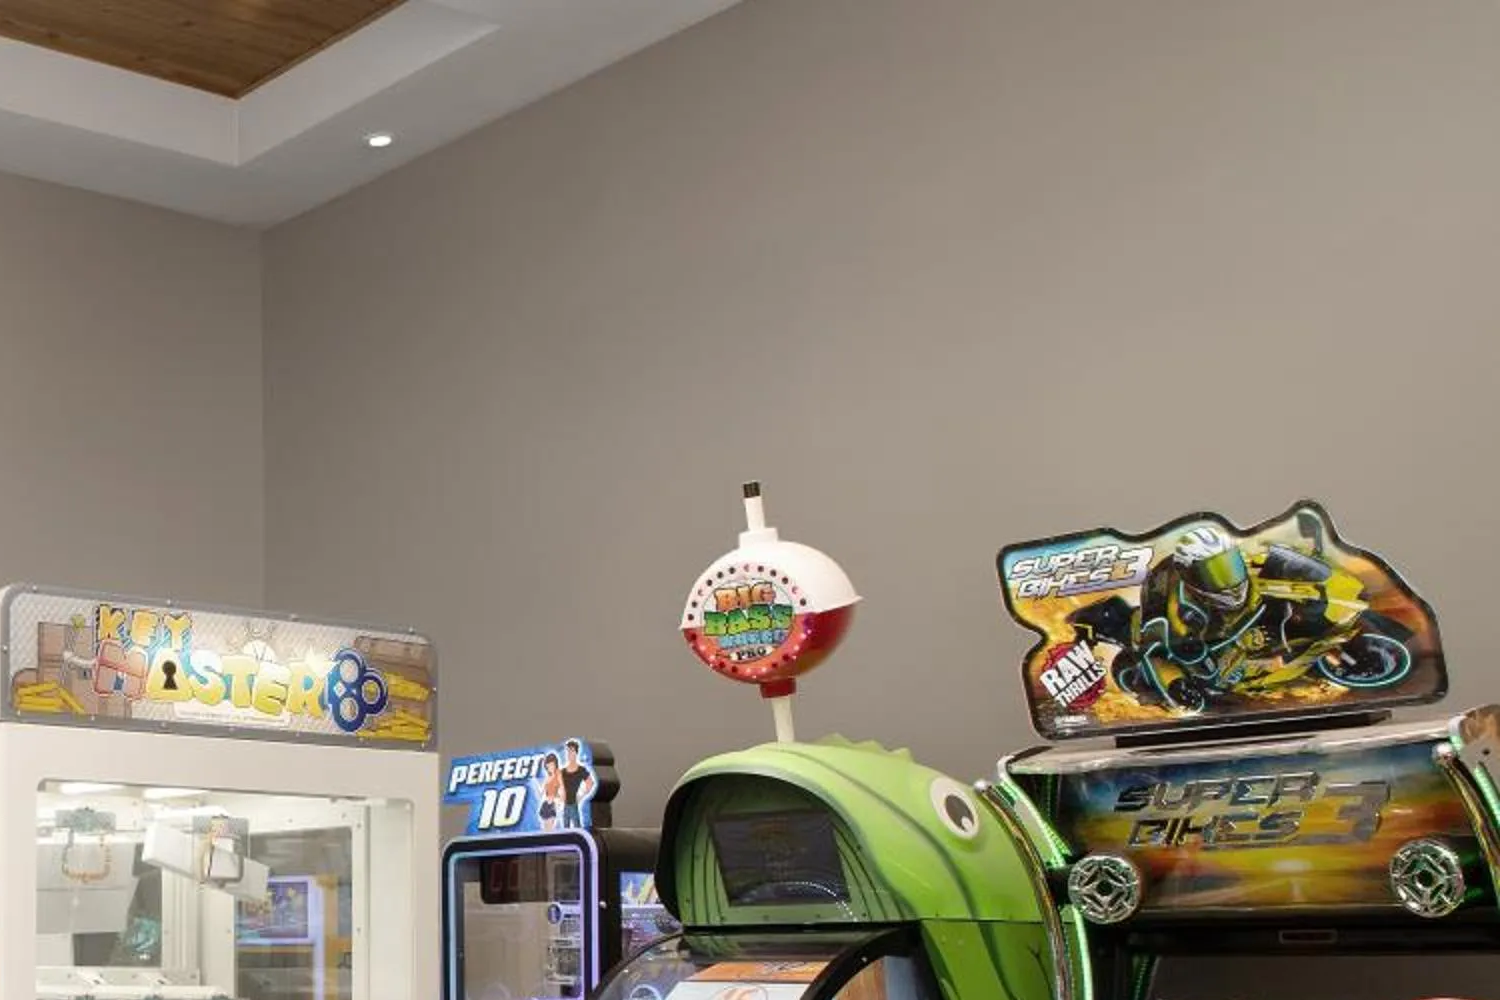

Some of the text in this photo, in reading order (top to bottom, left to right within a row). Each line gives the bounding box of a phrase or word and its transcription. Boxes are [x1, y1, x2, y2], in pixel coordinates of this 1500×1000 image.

[1012, 545, 1119, 576] SUPER
[714, 582, 774, 612] BIG
[97, 603, 192, 650] KEY
[703, 604, 792, 636] BASS
[737, 645, 767, 661] PRO
[1040, 640, 1096, 697] RAW
[93, 638, 328, 720] MASTER
[1054, 660, 1107, 708] THRILLS
[449, 753, 546, 793] PERFECT
[1114, 771, 1320, 812] SUPER
[478, 785, 527, 830] 10
